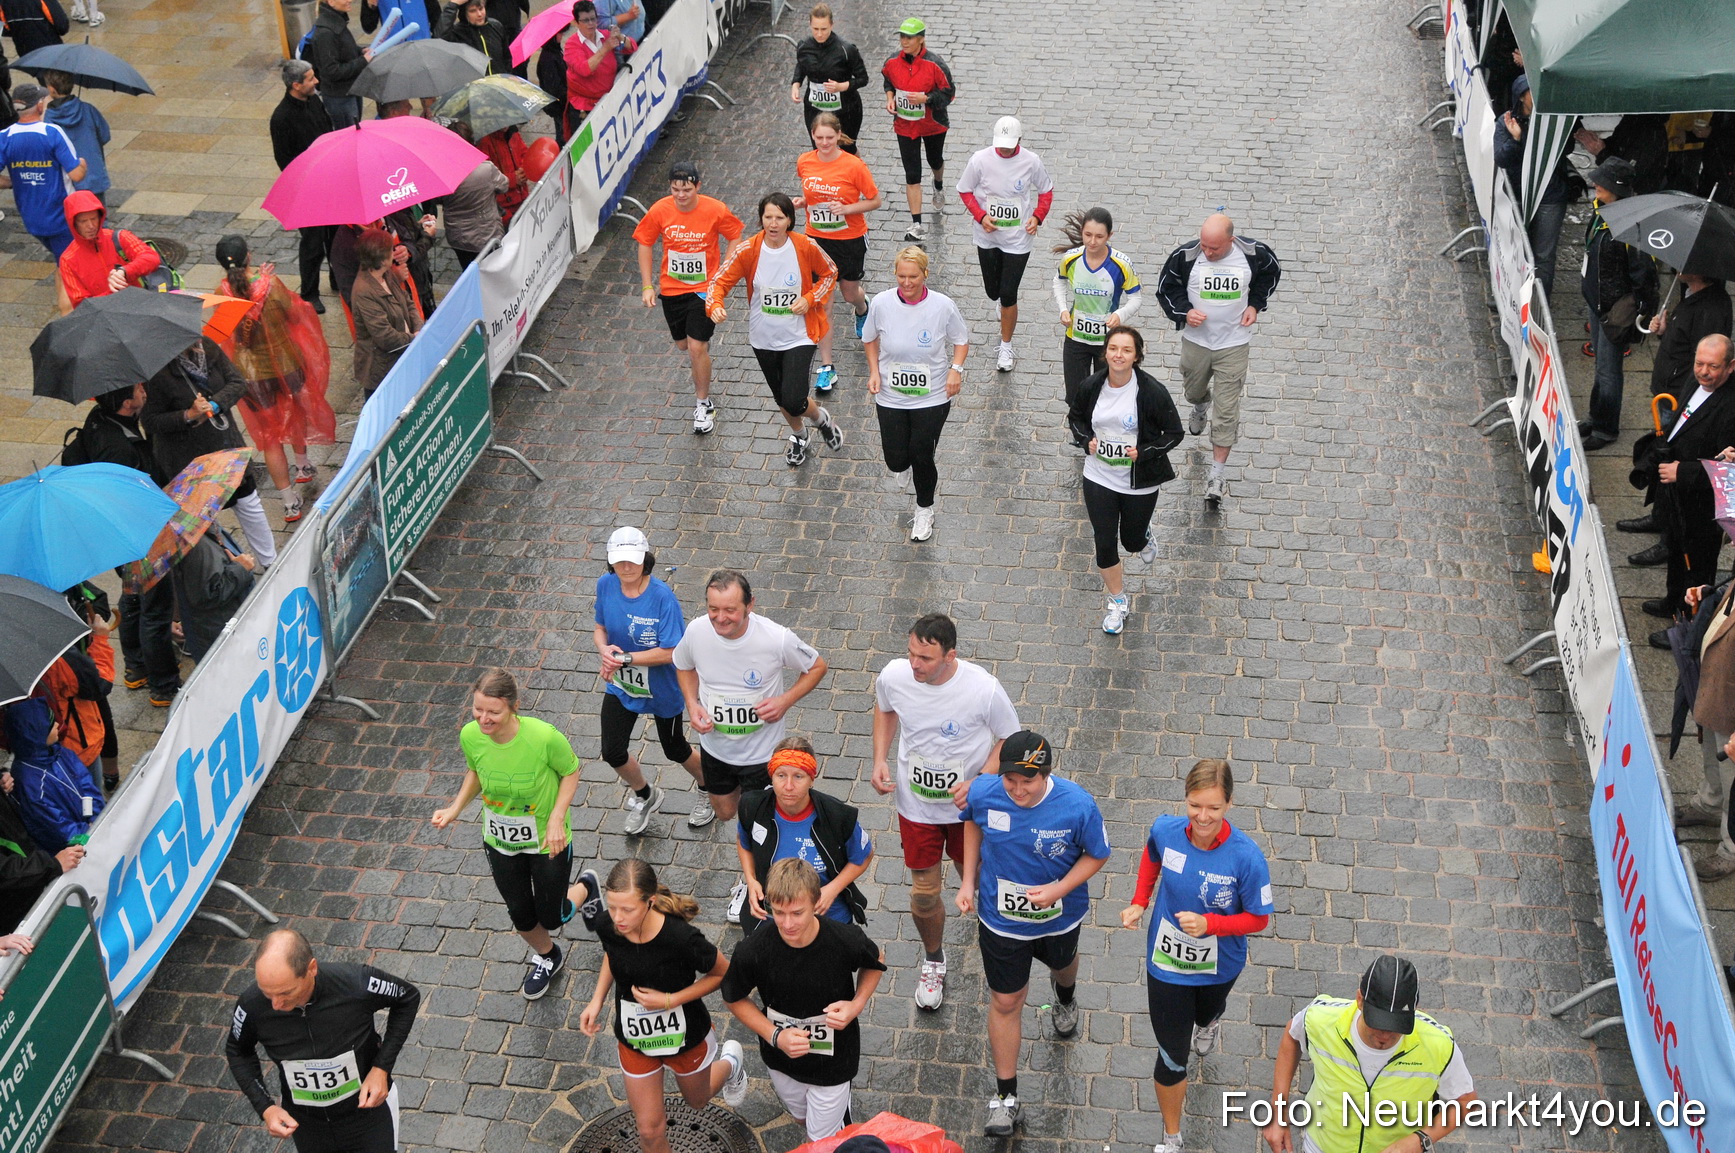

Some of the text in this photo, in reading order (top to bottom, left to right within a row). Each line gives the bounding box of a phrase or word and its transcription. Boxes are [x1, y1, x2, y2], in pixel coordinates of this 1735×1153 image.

[812, 91, 837, 102] 5005
[595, 49, 667, 189] BOCK
[808, 181, 841, 192] Fischer
[989, 205, 1019, 219] 5090
[671, 230, 706, 239] Fischer
[671, 260, 703, 273] 5189
[1075, 288, 1108, 296] BOCK
[1204, 277, 1239, 291] 5046
[764, 294, 797, 306] 5122
[491, 318, 503, 338] Ihr
[1077, 319, 1107, 335] 5031
[892, 372, 927, 387] 5099
[398, 381, 449, 453] Event-Leit-Systeme
[387, 415, 454, 513] Fun & Action in
[390, 425, 463, 540] sicheren Bahnen!
[406, 534, 413, 547] &
[413, 510, 432, 541] Service
[431, 490, 445, 514] Line:
[444, 468, 460, 493] 09181
[460, 446, 473, 469] 6352
[616, 666, 645, 688] 114
[713, 706, 759, 724] 5106
[913, 766, 958, 789] 5052
[97, 669, 269, 982] kstar
[489, 820, 533, 842] 5129
[1004, 893, 1056, 912] 52
[1161, 935, 1211, 962] 5157
[1171, 959, 1197, 970] Nicole
[1611, 812, 1712, 1153] TUI ReiseCent
[627, 1011, 680, 1037] 5044
[774, 1020, 828, 1040] 45
[638, 1037, 674, 1049] Manuela
[0, 1041, 37, 1113] heit
[293, 1065, 350, 1090] 5131
[312, 1090, 340, 1101] Dieter
[24, 1065, 78, 1153] 09181 6352
